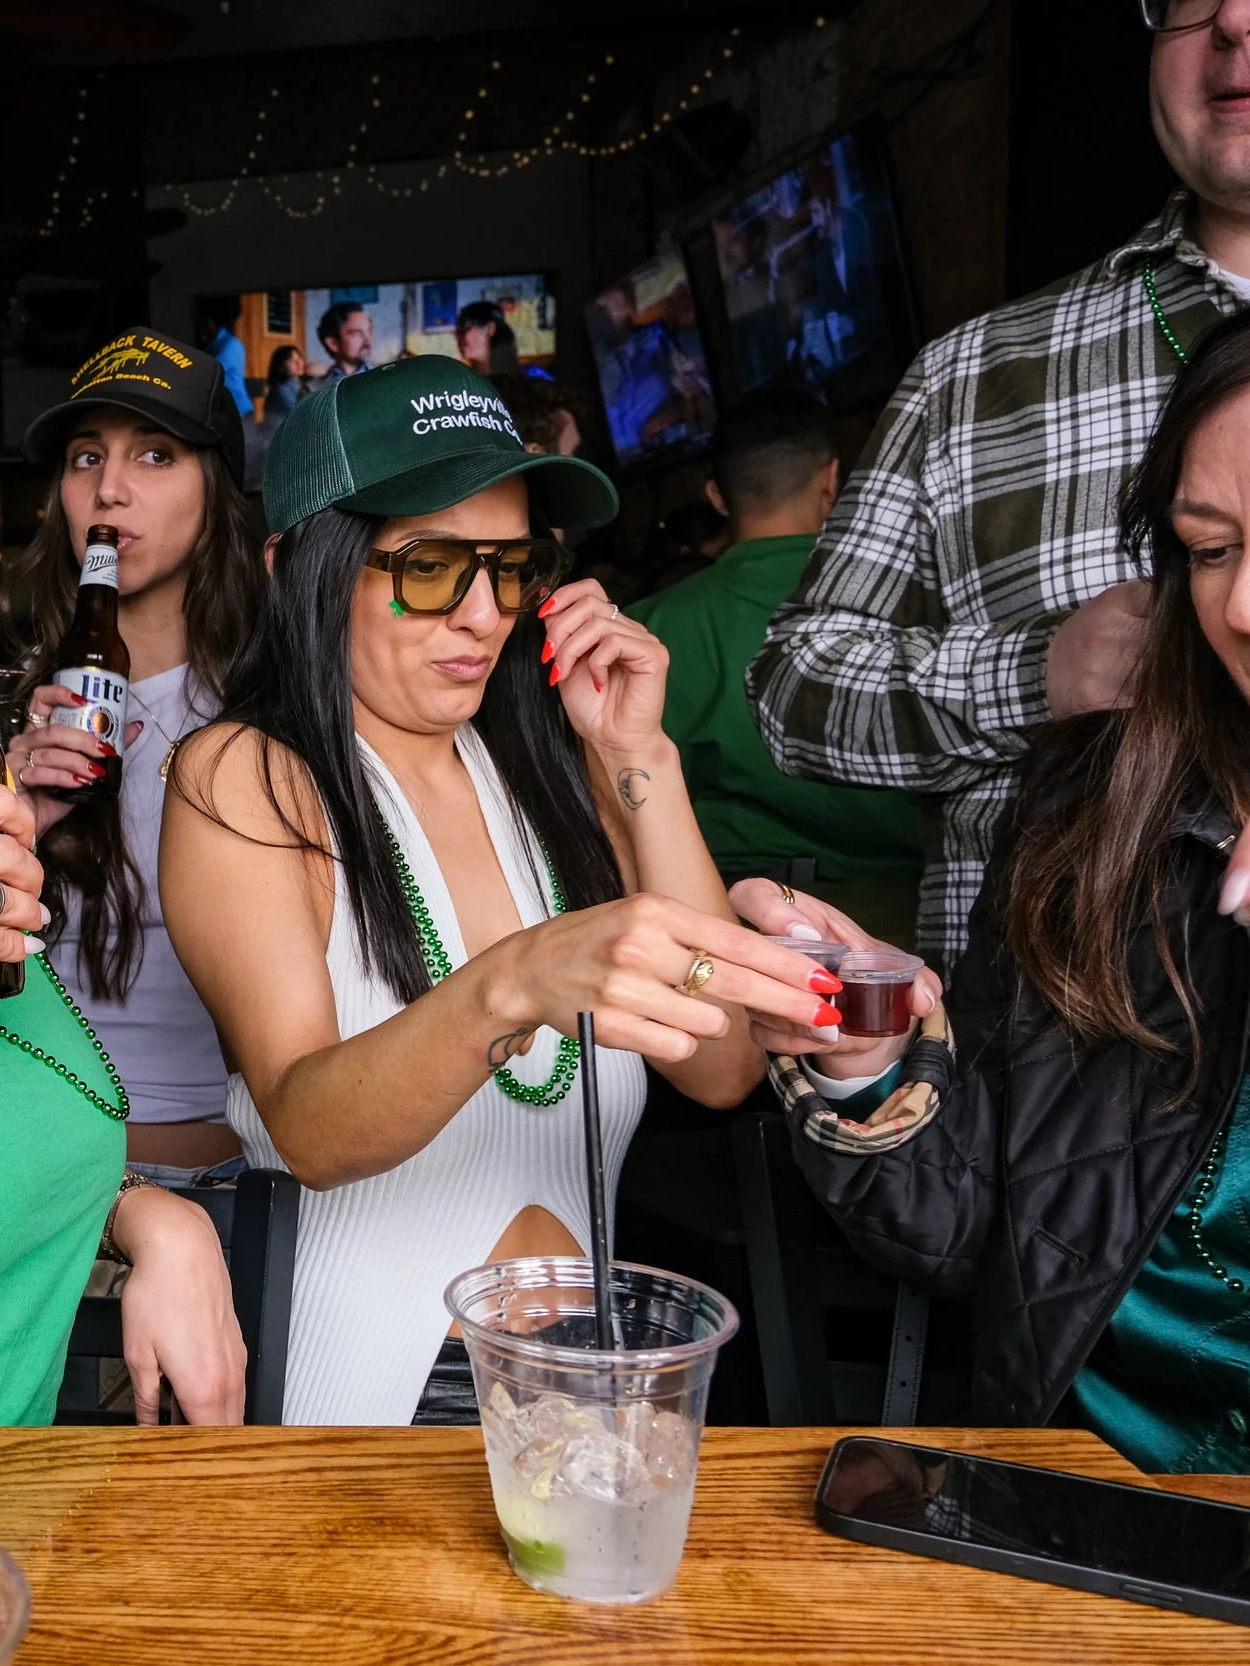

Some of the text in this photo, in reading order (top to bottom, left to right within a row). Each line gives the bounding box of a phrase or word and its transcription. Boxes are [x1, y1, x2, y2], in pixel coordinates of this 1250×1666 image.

[141, 336, 193, 369] TAVERN
[115, 373, 150, 382] Beach
[152, 377, 171, 390] Ca.
[412, 412, 503, 435] Crawfish
